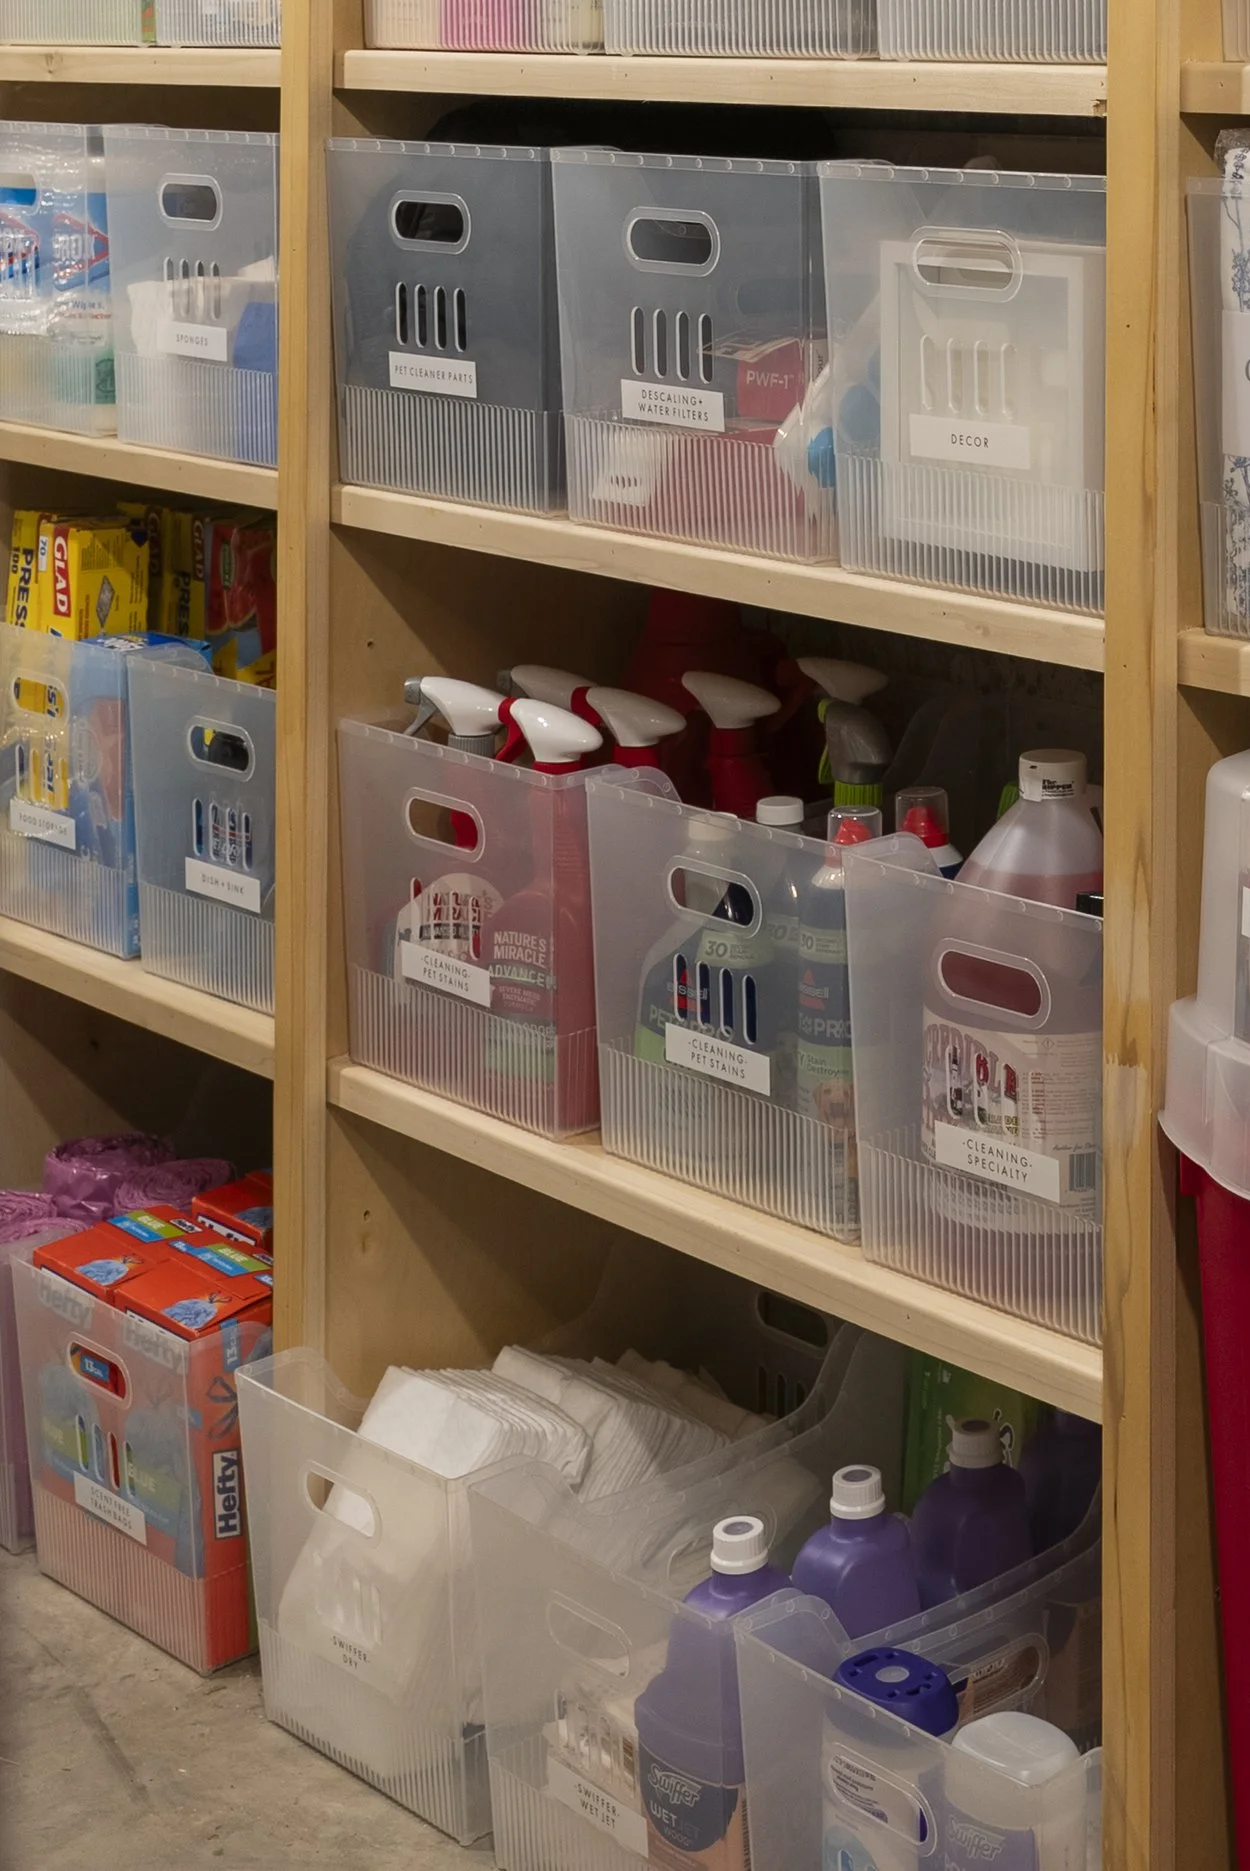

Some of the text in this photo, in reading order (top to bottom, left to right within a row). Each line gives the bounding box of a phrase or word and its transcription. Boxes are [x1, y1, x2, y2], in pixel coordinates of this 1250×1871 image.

[176, 334, 208, 346] SPONGES
[395, 365, 473, 384] PET CLEANER PARTS
[638, 402, 709, 421] WATER FILTERS
[951, 433, 989, 448] DECOR
[39, 538, 48, 557] 70
[54, 535, 68, 613] GLAD
[16, 547, 33, 628] PRES
[202, 873, 219, 887] DISH
[227, 881, 245, 894] SINK
[494, 945, 547, 968] MIRACLE
[706, 940, 727, 957] 30
[423, 967, 469, 992] PET STAINS
[691, 1051, 745, 1078] PET STAINS
[968, 1154, 1028, 1182] SPECIALTY
[217, 1452, 238, 1535] Hefty
[113, 1512, 132, 1529] BAGS
[343, 1654, 358, 1669] DRY
[649, 1764, 701, 1808] Swiffer
[581, 1799, 616, 1828] WET JET
